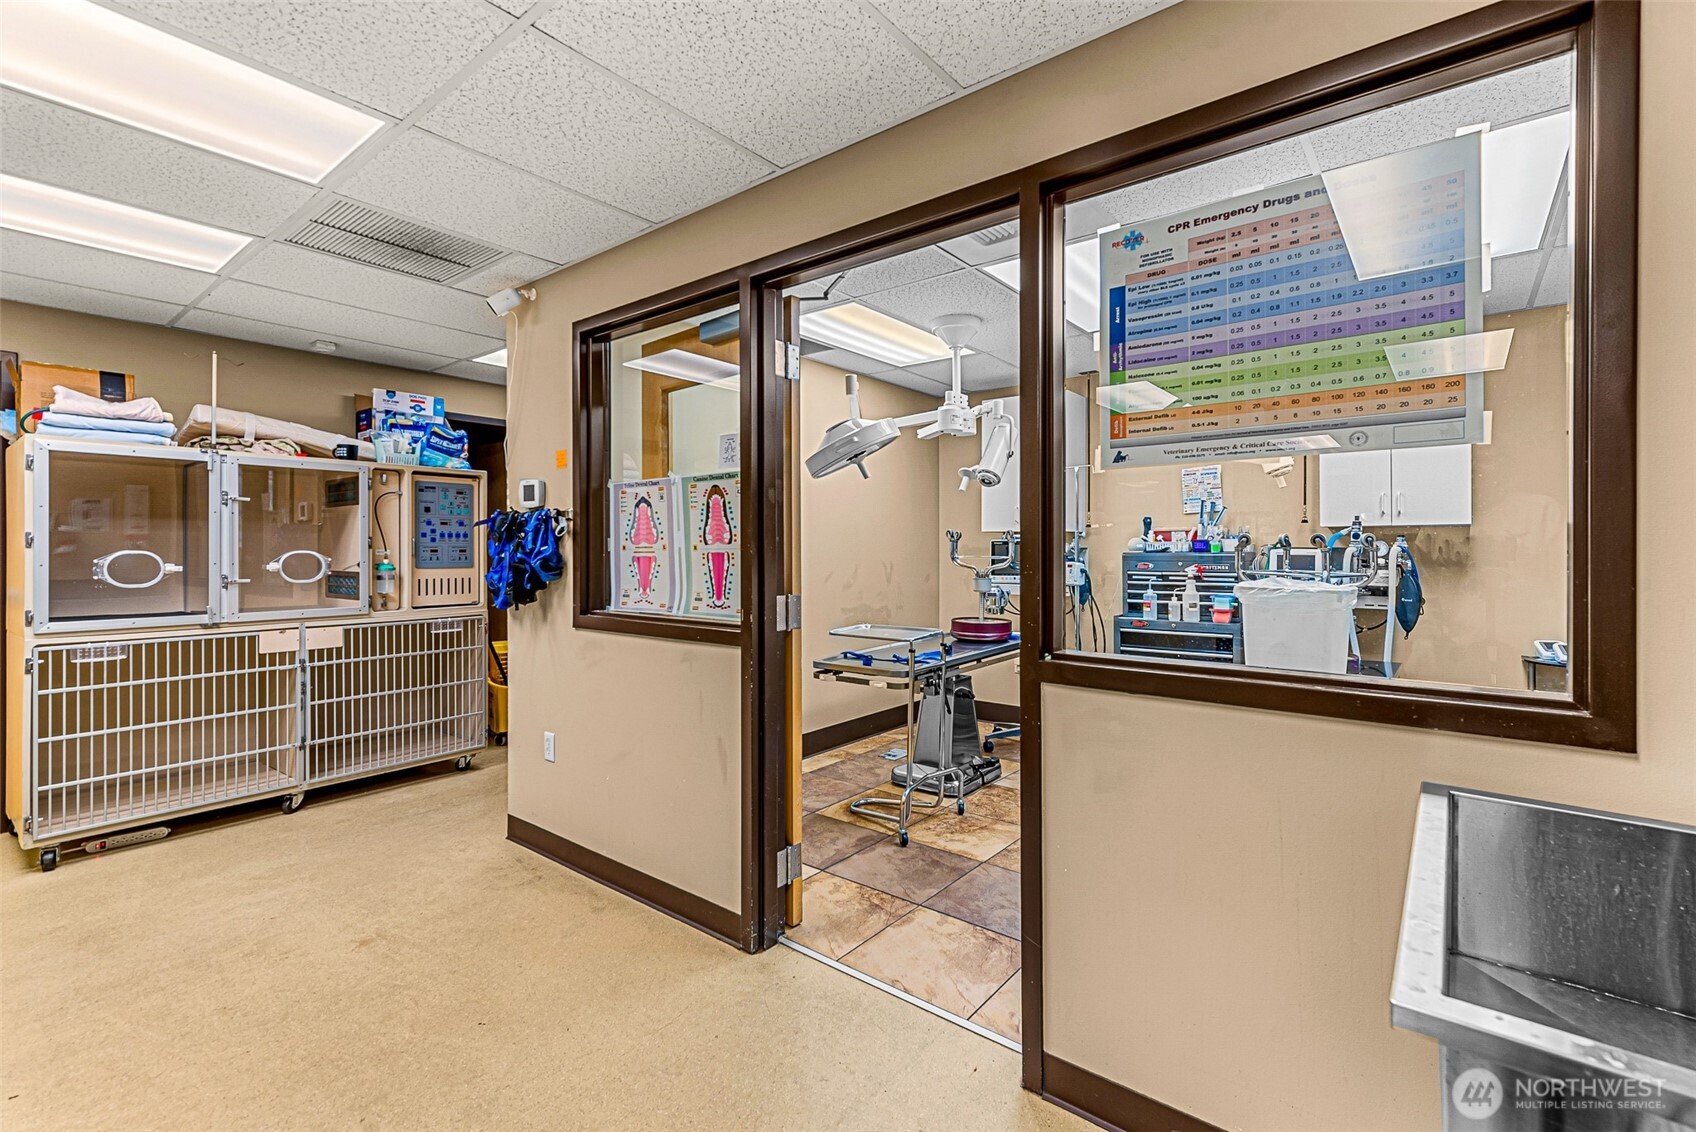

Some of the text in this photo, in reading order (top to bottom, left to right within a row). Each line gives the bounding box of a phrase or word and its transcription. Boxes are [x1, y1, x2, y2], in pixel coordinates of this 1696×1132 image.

[1168, 187, 1328, 233] CPR Emergency Drugs and
[1198, 257, 1217, 266] DOSE
[1147, 269, 1166, 278] DRUG
[1446, 271, 1458, 279] 3.7
[1375, 388, 1388, 396] 140
[1445, 380, 1460, 388] 200
[1163, 447, 1194, 455] Veterinary
[1196, 443, 1230, 453] Emergency
